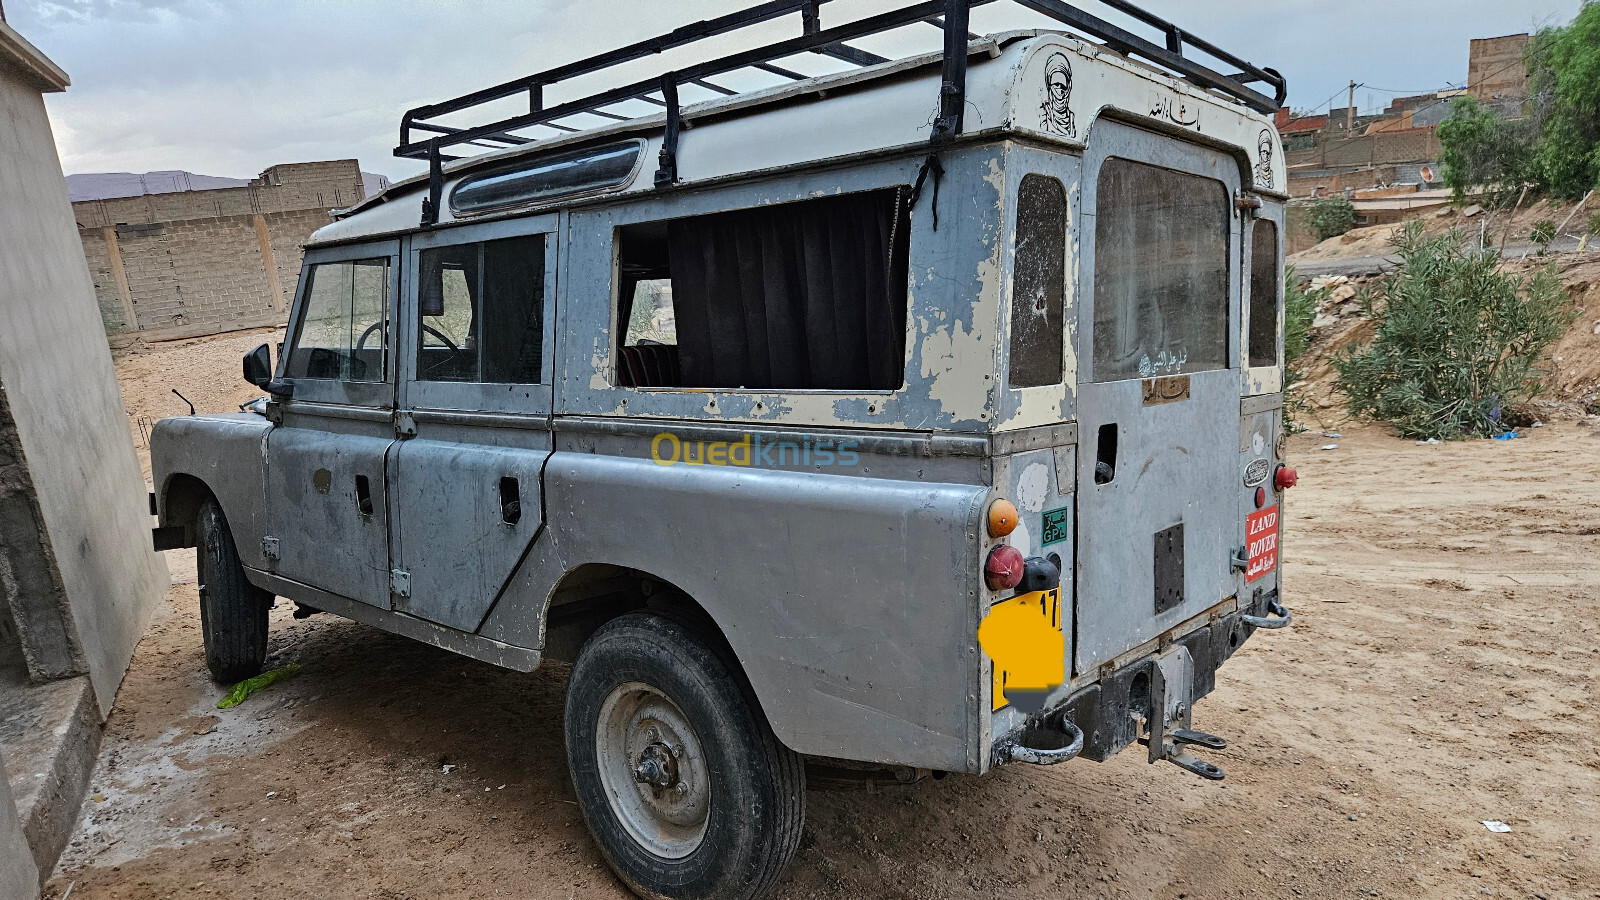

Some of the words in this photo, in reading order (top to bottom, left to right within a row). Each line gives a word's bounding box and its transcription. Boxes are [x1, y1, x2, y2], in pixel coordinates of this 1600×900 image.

[1043, 527, 1066, 543] GPL
[1249, 512, 1277, 536] LAND
[1248, 533, 1277, 560] ROVER
